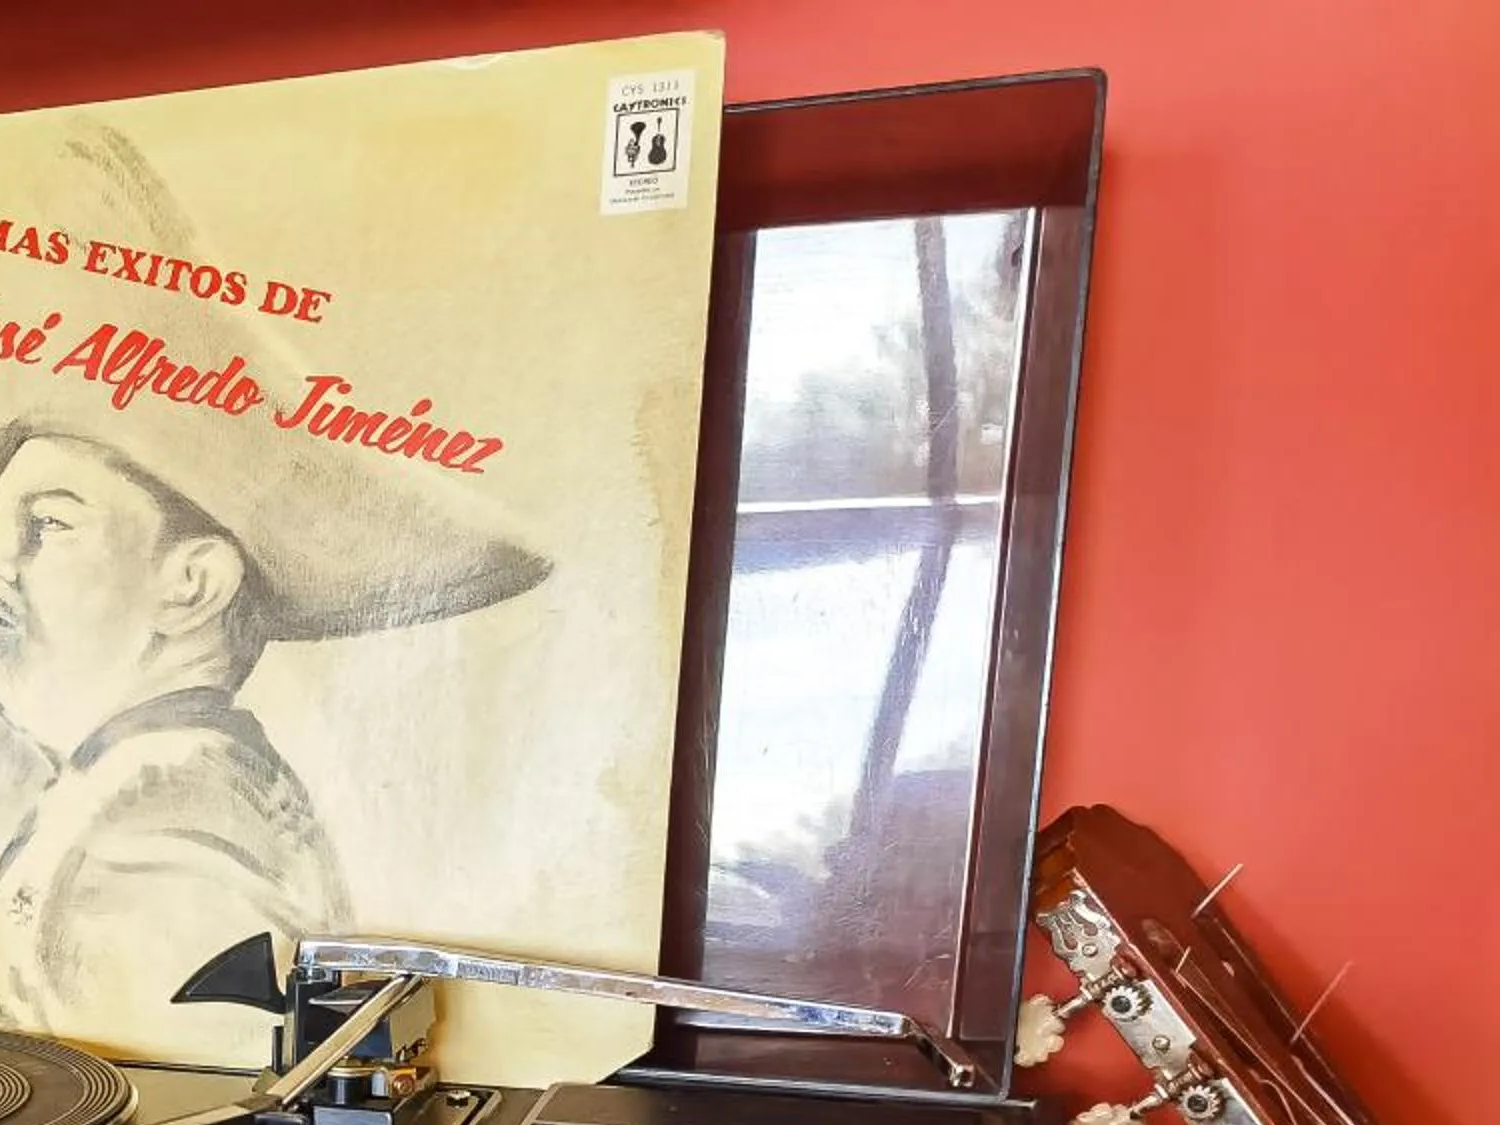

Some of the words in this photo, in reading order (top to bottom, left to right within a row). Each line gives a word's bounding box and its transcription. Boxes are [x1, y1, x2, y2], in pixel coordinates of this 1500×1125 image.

[82, 241, 248, 306] EXITOS
[258, 280, 333, 324] DE
[53, 323, 264, 410] Alfredo
[274, 374, 504, 475] Jiménez
